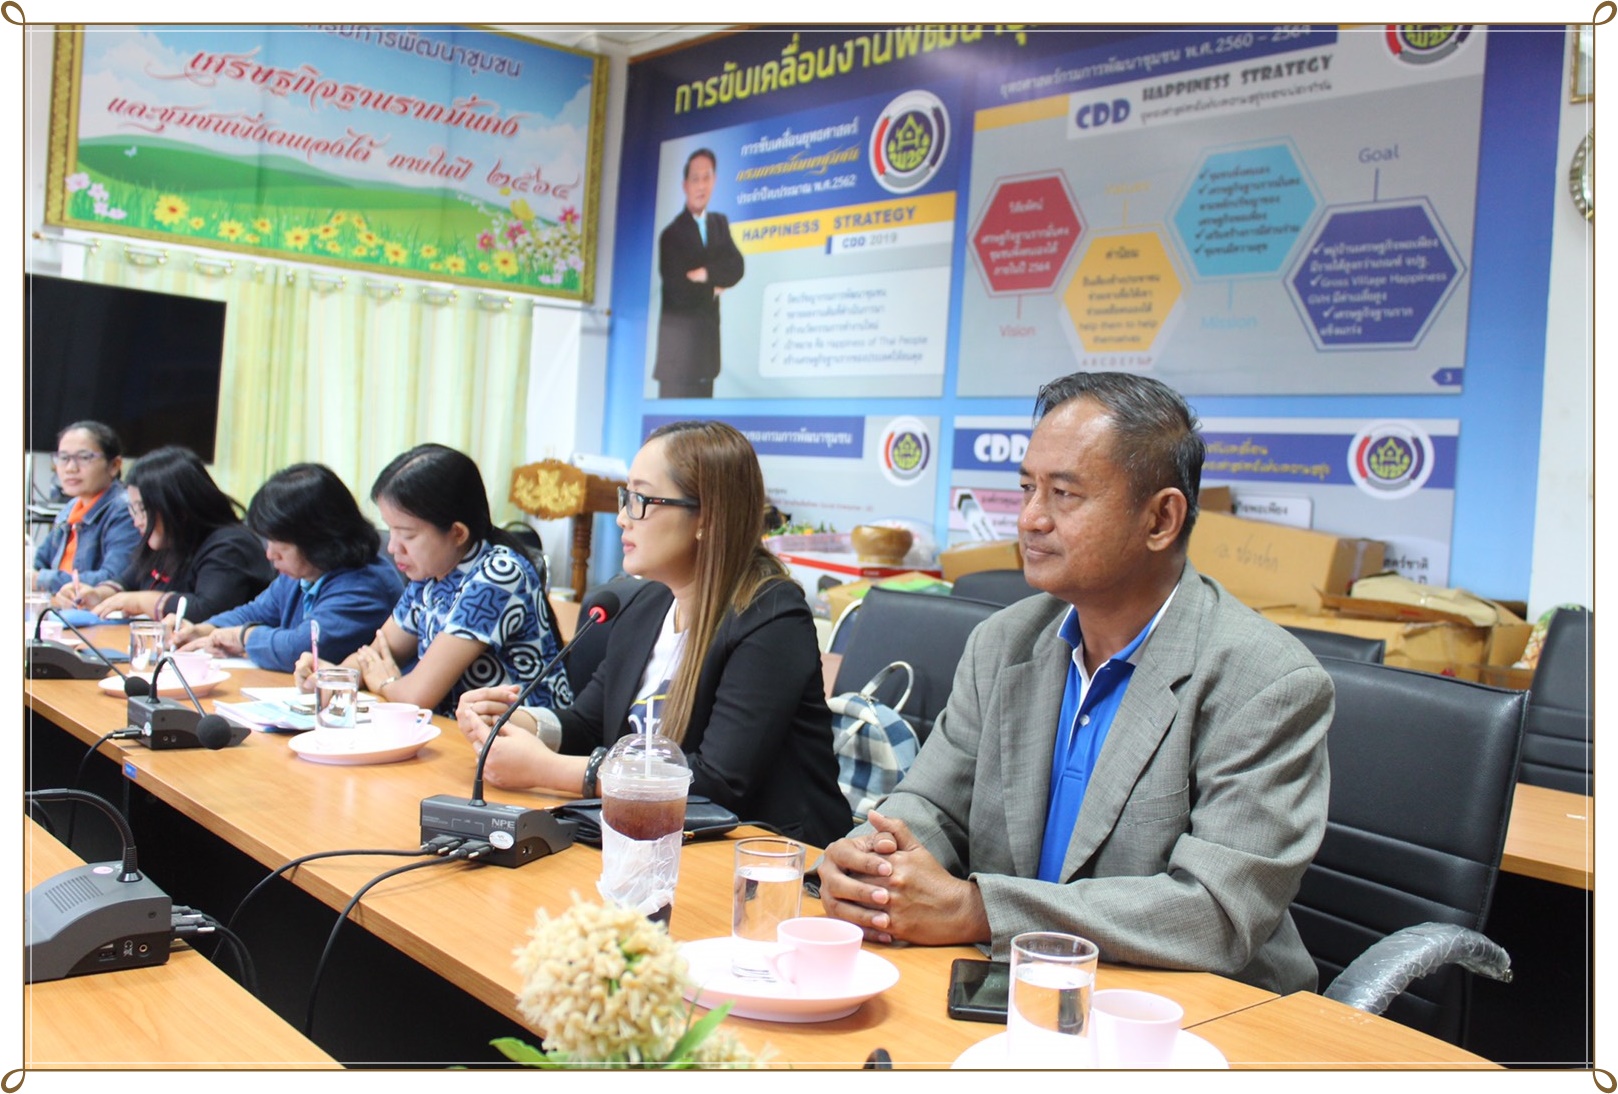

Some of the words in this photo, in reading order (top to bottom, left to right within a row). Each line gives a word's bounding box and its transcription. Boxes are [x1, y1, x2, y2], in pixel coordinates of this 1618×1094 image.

[185, 46, 535, 138] เศรษฐกิจฐานรากมั่นคง
[1142, 73, 1230, 102] HAPPINESS
[1240, 54, 1334, 85] STRATEGY
[1075, 98, 1131, 129] CDD
[107, 97, 390, 165] และชุมชนพึ่งตนเองได้
[386, 144, 474, 182] ภายในปี
[486, 157, 580, 200] ๒๕๖๔
[1358, 145, 1399, 164] Goal
[742, 219, 820, 242] HAPPINESS
[834, 206, 917, 230] STRATEGY
[842, 236, 866, 248] CDD
[869, 232, 898, 246] 2019
[1351, 275, 1387, 287] Village
[1389, 272, 1447, 285] Happiness
[999, 325, 1036, 337] Vision
[974, 433, 1031, 463] CDD
[491, 818, 515, 829] NPE
